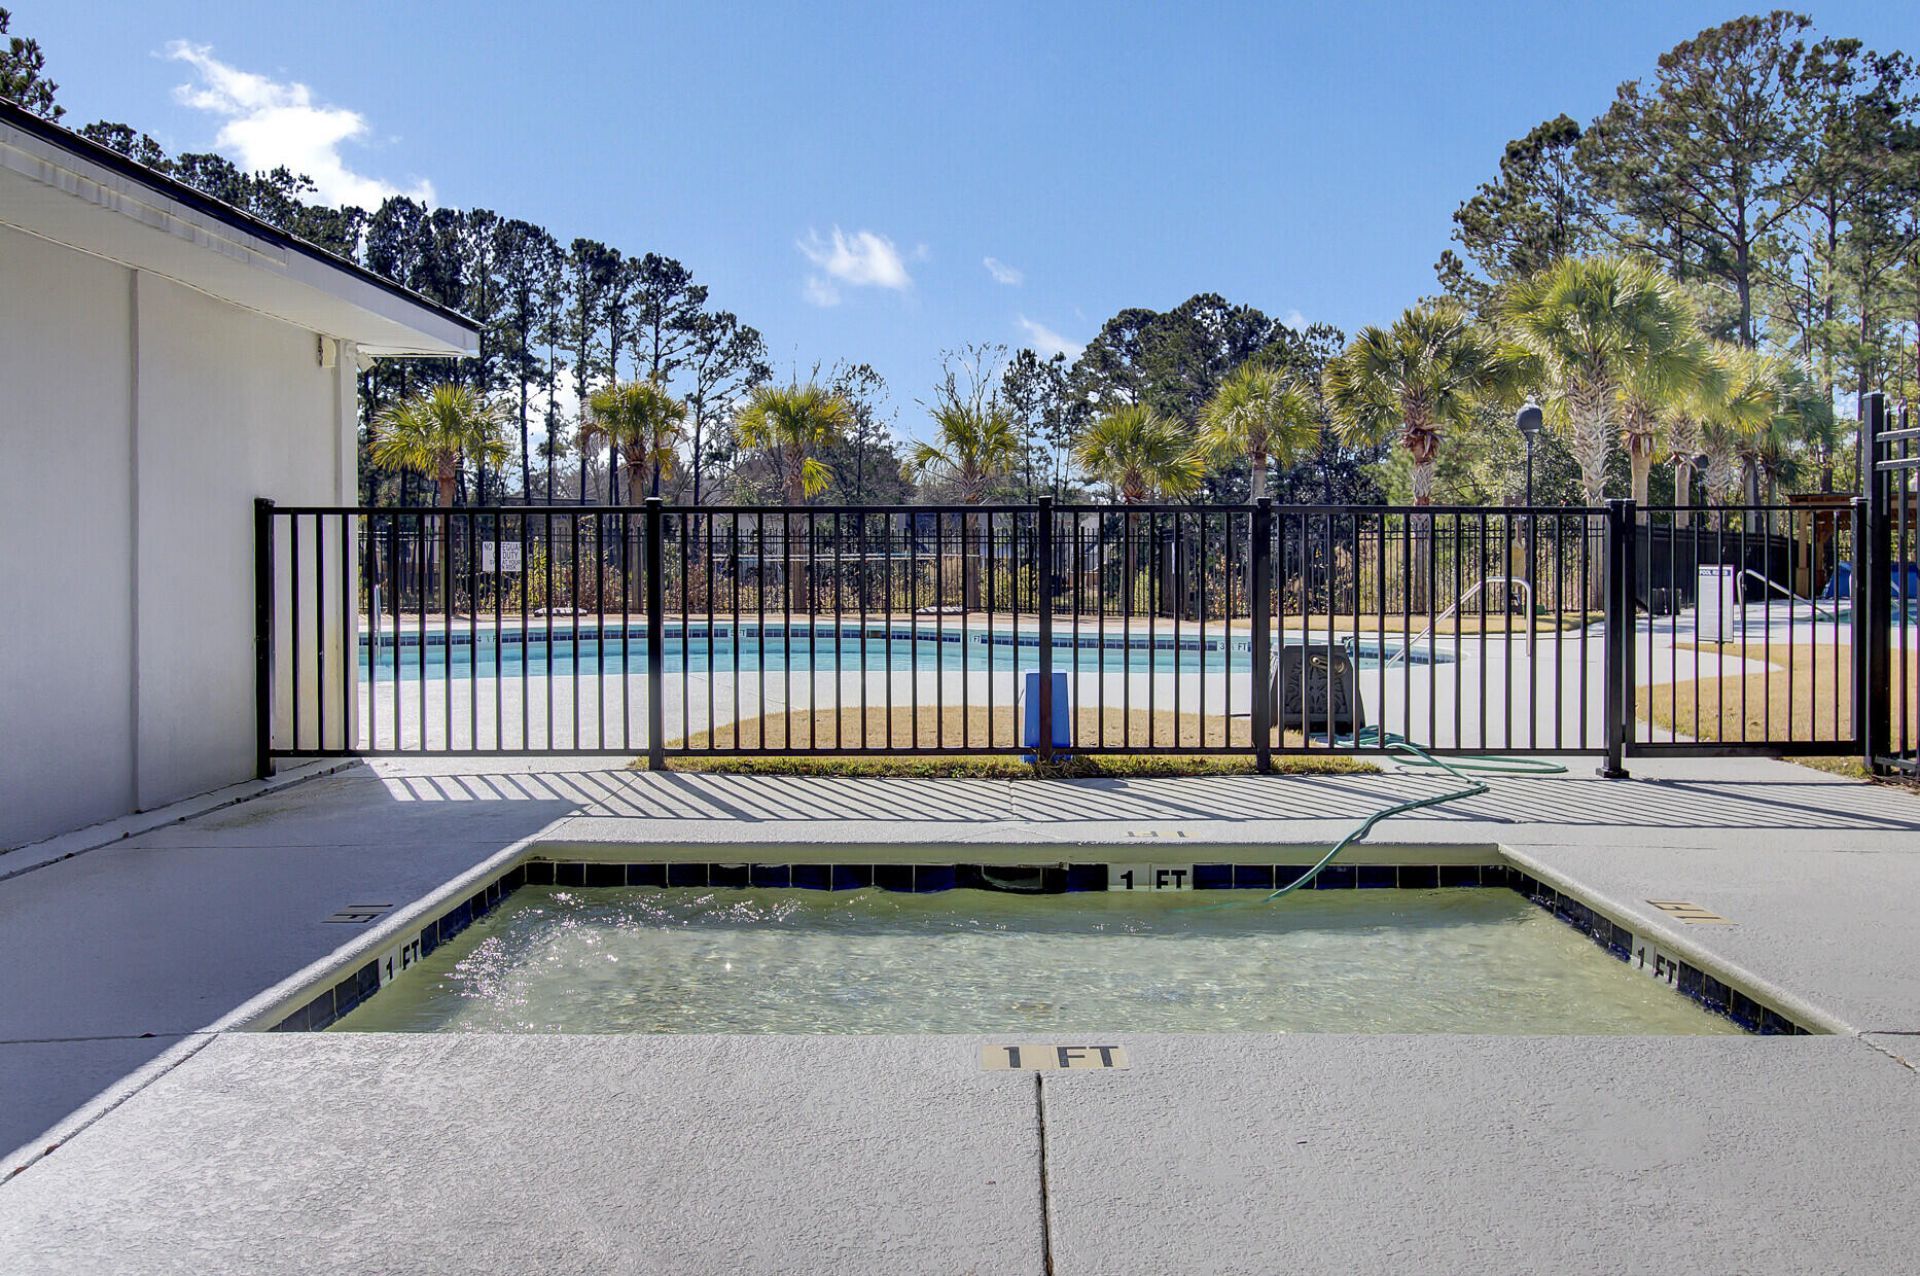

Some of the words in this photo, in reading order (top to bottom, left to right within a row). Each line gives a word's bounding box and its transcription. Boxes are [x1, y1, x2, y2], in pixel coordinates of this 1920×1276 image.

[484, 543, 493, 551] NO
[503, 551, 518, 559] DUTY
[1120, 870, 1134, 889] 1
[1156, 870, 1187, 889] FT
[386, 956, 394, 980] 1
[402, 939, 420, 971] FT
[1637, 947, 1645, 969] 1
[1654, 954, 1677, 984] FT
[1003, 1046, 1022, 1069] 1
[1057, 1046, 1119, 1068] FT
